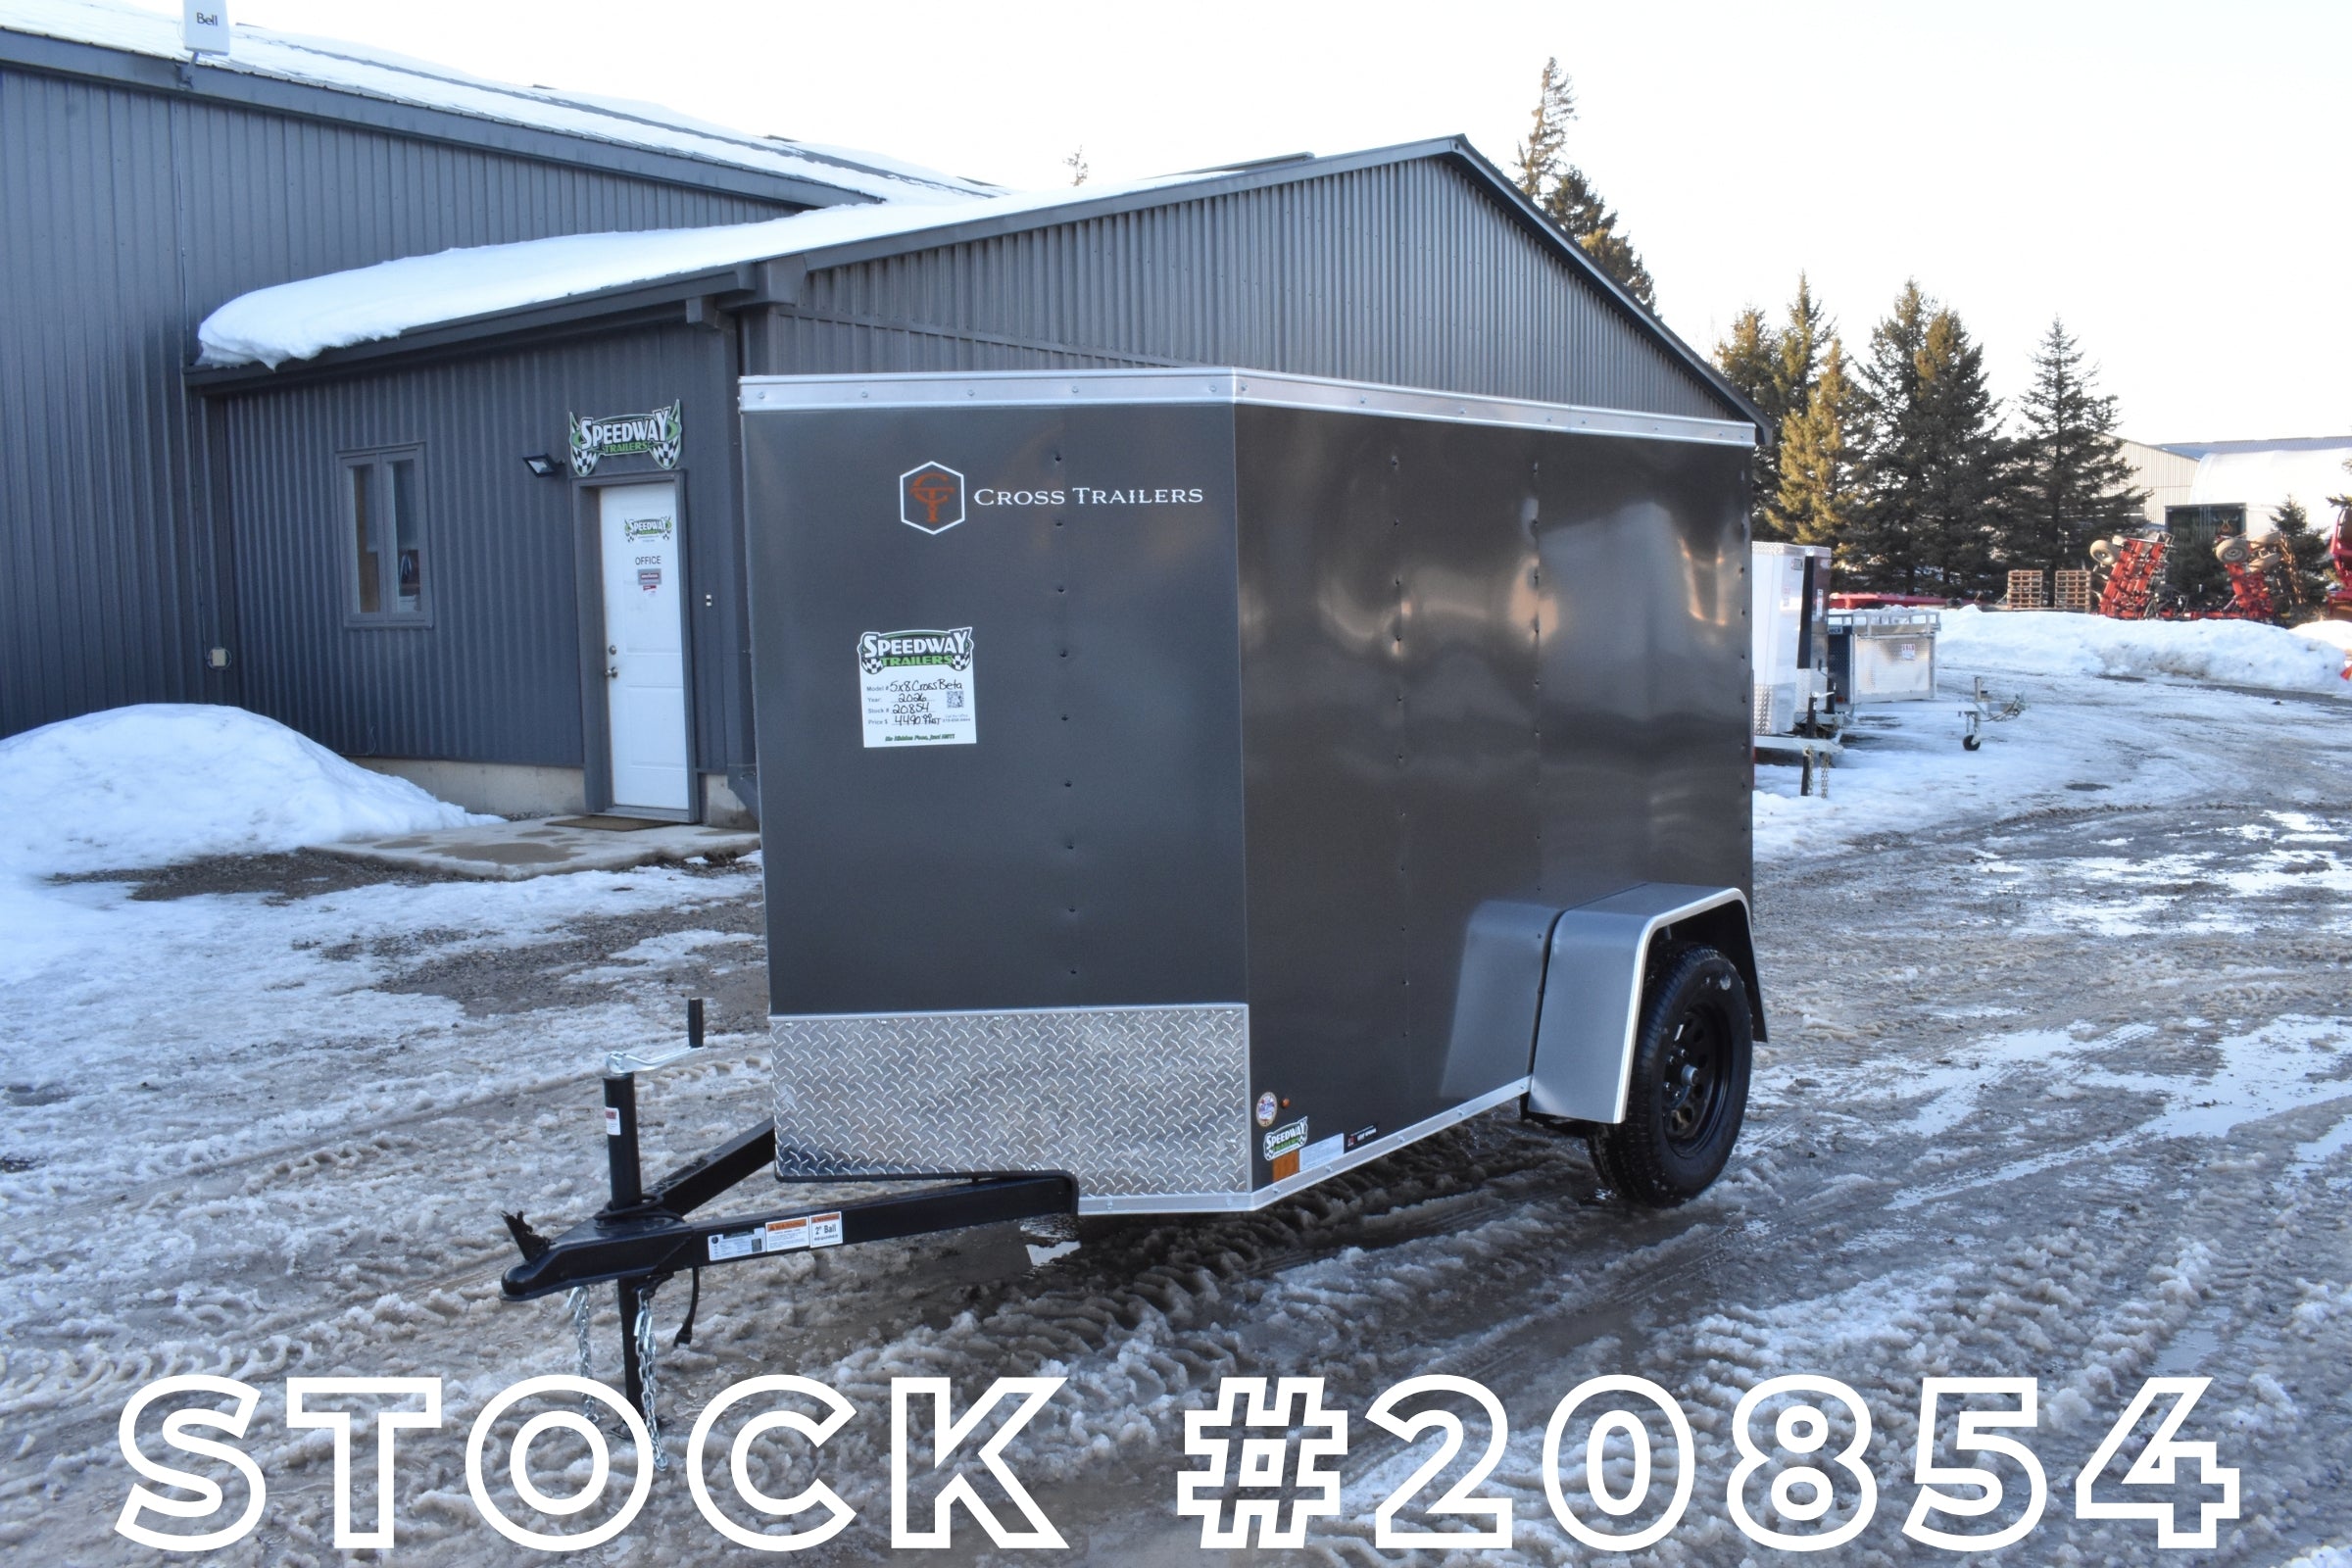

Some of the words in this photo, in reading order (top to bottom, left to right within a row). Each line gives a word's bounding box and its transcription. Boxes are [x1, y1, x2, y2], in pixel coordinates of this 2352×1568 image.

[196, 12, 218, 26] Bell
[581, 411, 668, 450] SPEEDWAY
[604, 441, 648, 452] TRAILERS
[628, 517, 667, 534] SPEEDWAY
[635, 556, 662, 565] OFFICE
[863, 630, 968, 659] SPEEDWAY
[880, 655, 954, 666] TRAILERS
[890, 680, 910, 693] 5x8
[911, 679, 938, 692] Cross
[938, 678, 962, 691] Beta
[892, 703, 929, 714] 20854
[1266, 1120, 1305, 1150] SPEEDWAY
[823, 1223, 837, 1234] Ball
